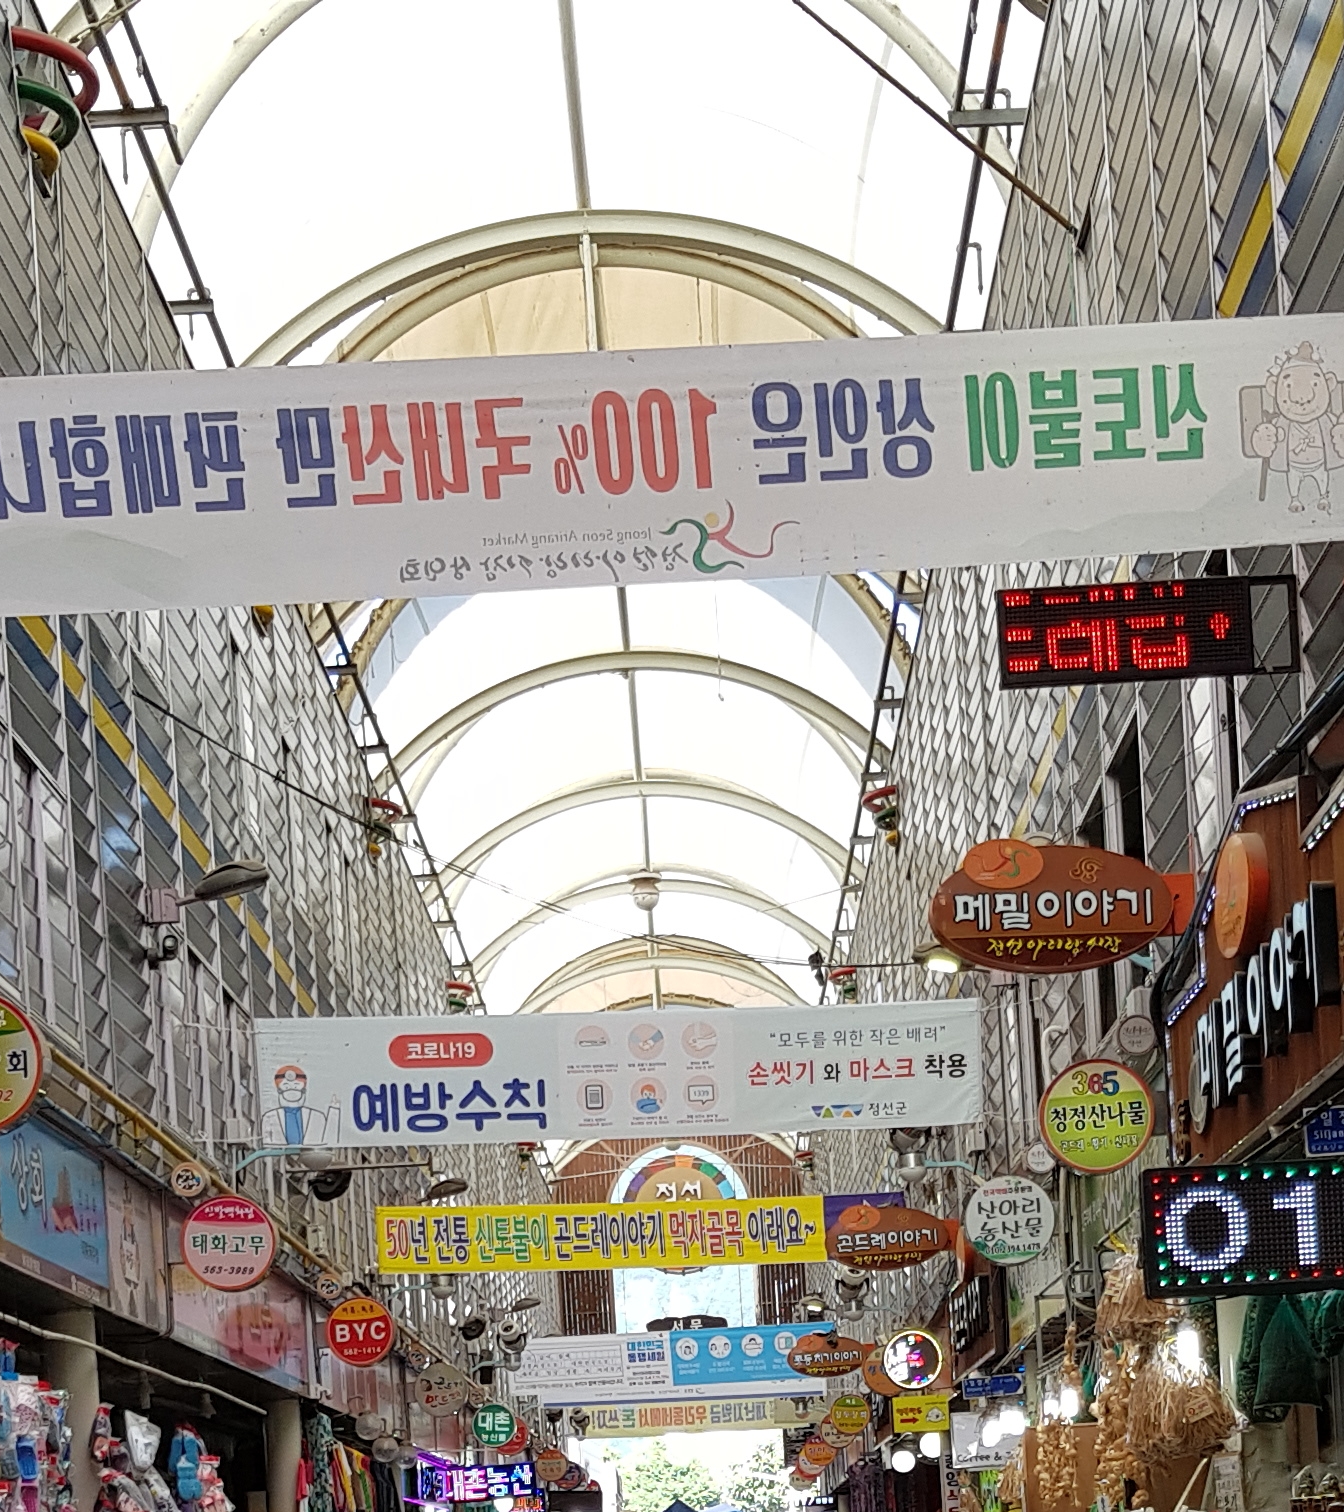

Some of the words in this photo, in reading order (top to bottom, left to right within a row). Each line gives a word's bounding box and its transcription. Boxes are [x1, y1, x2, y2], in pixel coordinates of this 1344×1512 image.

[953, 887, 1154, 932] 메밀이야기
[987, 936, 1023, 958] 정선
[831, 1029, 864, 1049] 위한
[868, 1027, 901, 1046] 작은
[406, 1041, 476, 1060] 코로나19
[747, 1059, 815, 1087] 손씻기
[823, 1063, 842, 1084] 와
[849, 1057, 916, 1082] 마스크
[923, 1052, 968, 1079] 착용
[1071, 1070, 1121, 1097] 365
[352, 1077, 548, 1133] 예방수칙
[867, 1101, 908, 1118] 정선군
[1050, 1100, 1146, 1134] 청정산나물
[976, 1197, 1042, 1220] 산아리
[385, 1216, 431, 1262] 50년
[430, 1215, 470, 1264] 전통
[474, 1213, 550, 1261] 신토불이
[552, 1210, 665, 1261] 곤드레이야기
[668, 1209, 744, 1260] 먹자골목
[835, 1229, 939, 1254] 곤드레이야기
[978, 1217, 1044, 1243] 농산물
[191, 1233, 267, 1255] 태화고무
[335, 1319, 388, 1343] BYC
[477, 1411, 511, 1432] 대촌
